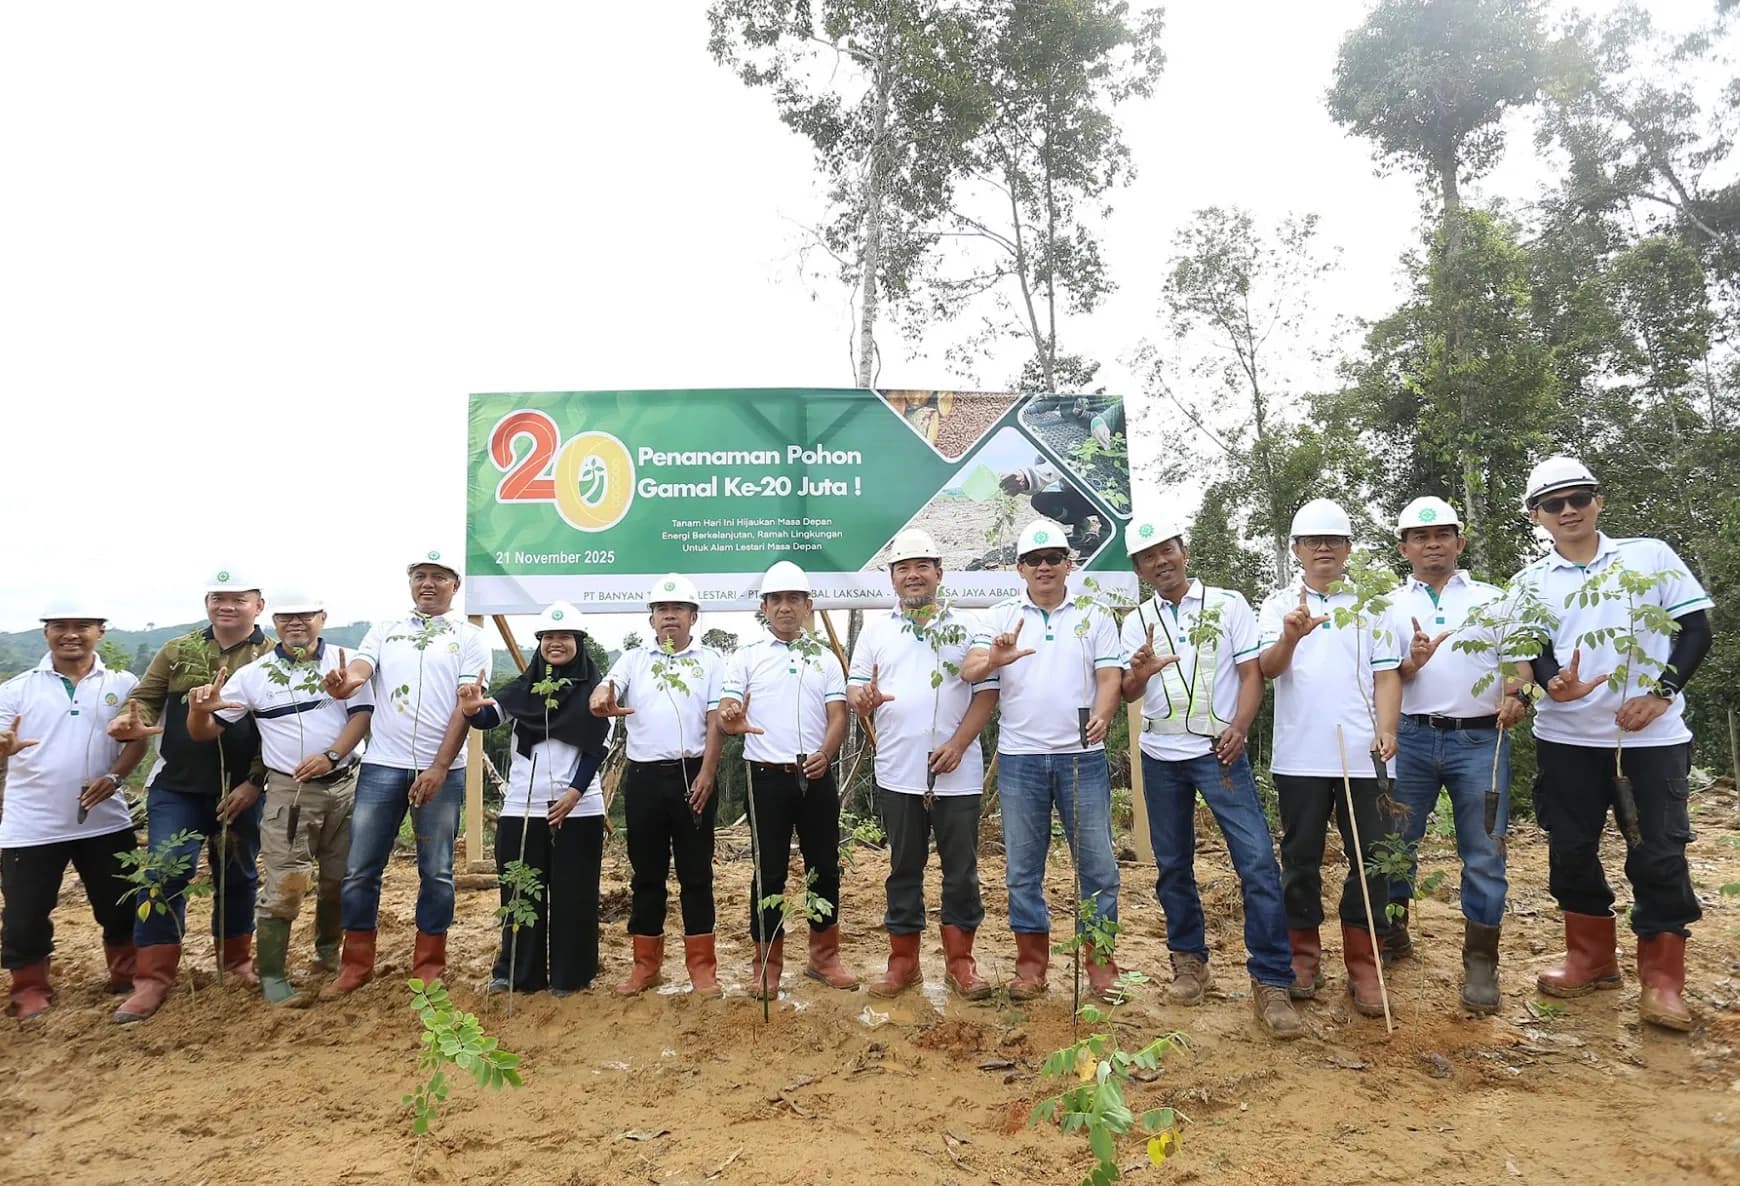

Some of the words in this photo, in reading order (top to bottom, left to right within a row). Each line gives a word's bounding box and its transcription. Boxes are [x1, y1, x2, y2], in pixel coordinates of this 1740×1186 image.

[638, 446, 780, 466] Penanaman
[787, 443, 862, 465] Pohon
[488, 409, 636, 533] 20
[637, 475, 718, 498] Gamal
[724, 475, 792, 497] Ke-20
[797, 476, 848, 496] Juta
[672, 519, 701, 527] Tanam
[703, 519, 722, 527] Hari
[723, 518, 735, 526] Ini
[737, 517, 776, 527] Hijaukan
[778, 518, 801, 526] Masa
[803, 517, 832, 527] Depan
[662, 531, 690, 541] Energi
[692, 531, 755, 540] Berkelanjutan,
[757, 530, 789, 539] Ramah
[791, 530, 843, 540] Lingkungan
[682, 543, 709, 552] Untuk
[710, 543, 734, 551] Alam
[735, 542, 765, 551] Lestari
[767, 542, 791, 550] Masa
[792, 541, 822, 551] Depan
[496, 551, 511, 564] 21
[515, 551, 581, 564] November
[584, 550, 615, 564] 2025
[583, 591, 596, 601] PT
[598, 591, 644, 601] BANYAN
[698, 590, 737, 600] LESTARI
[748, 589, 760, 600] PT
[833, 588, 883, 599] LAKSANA
[962, 587, 986, 597] JAYA
[988, 587, 1020, 597] ABADI
